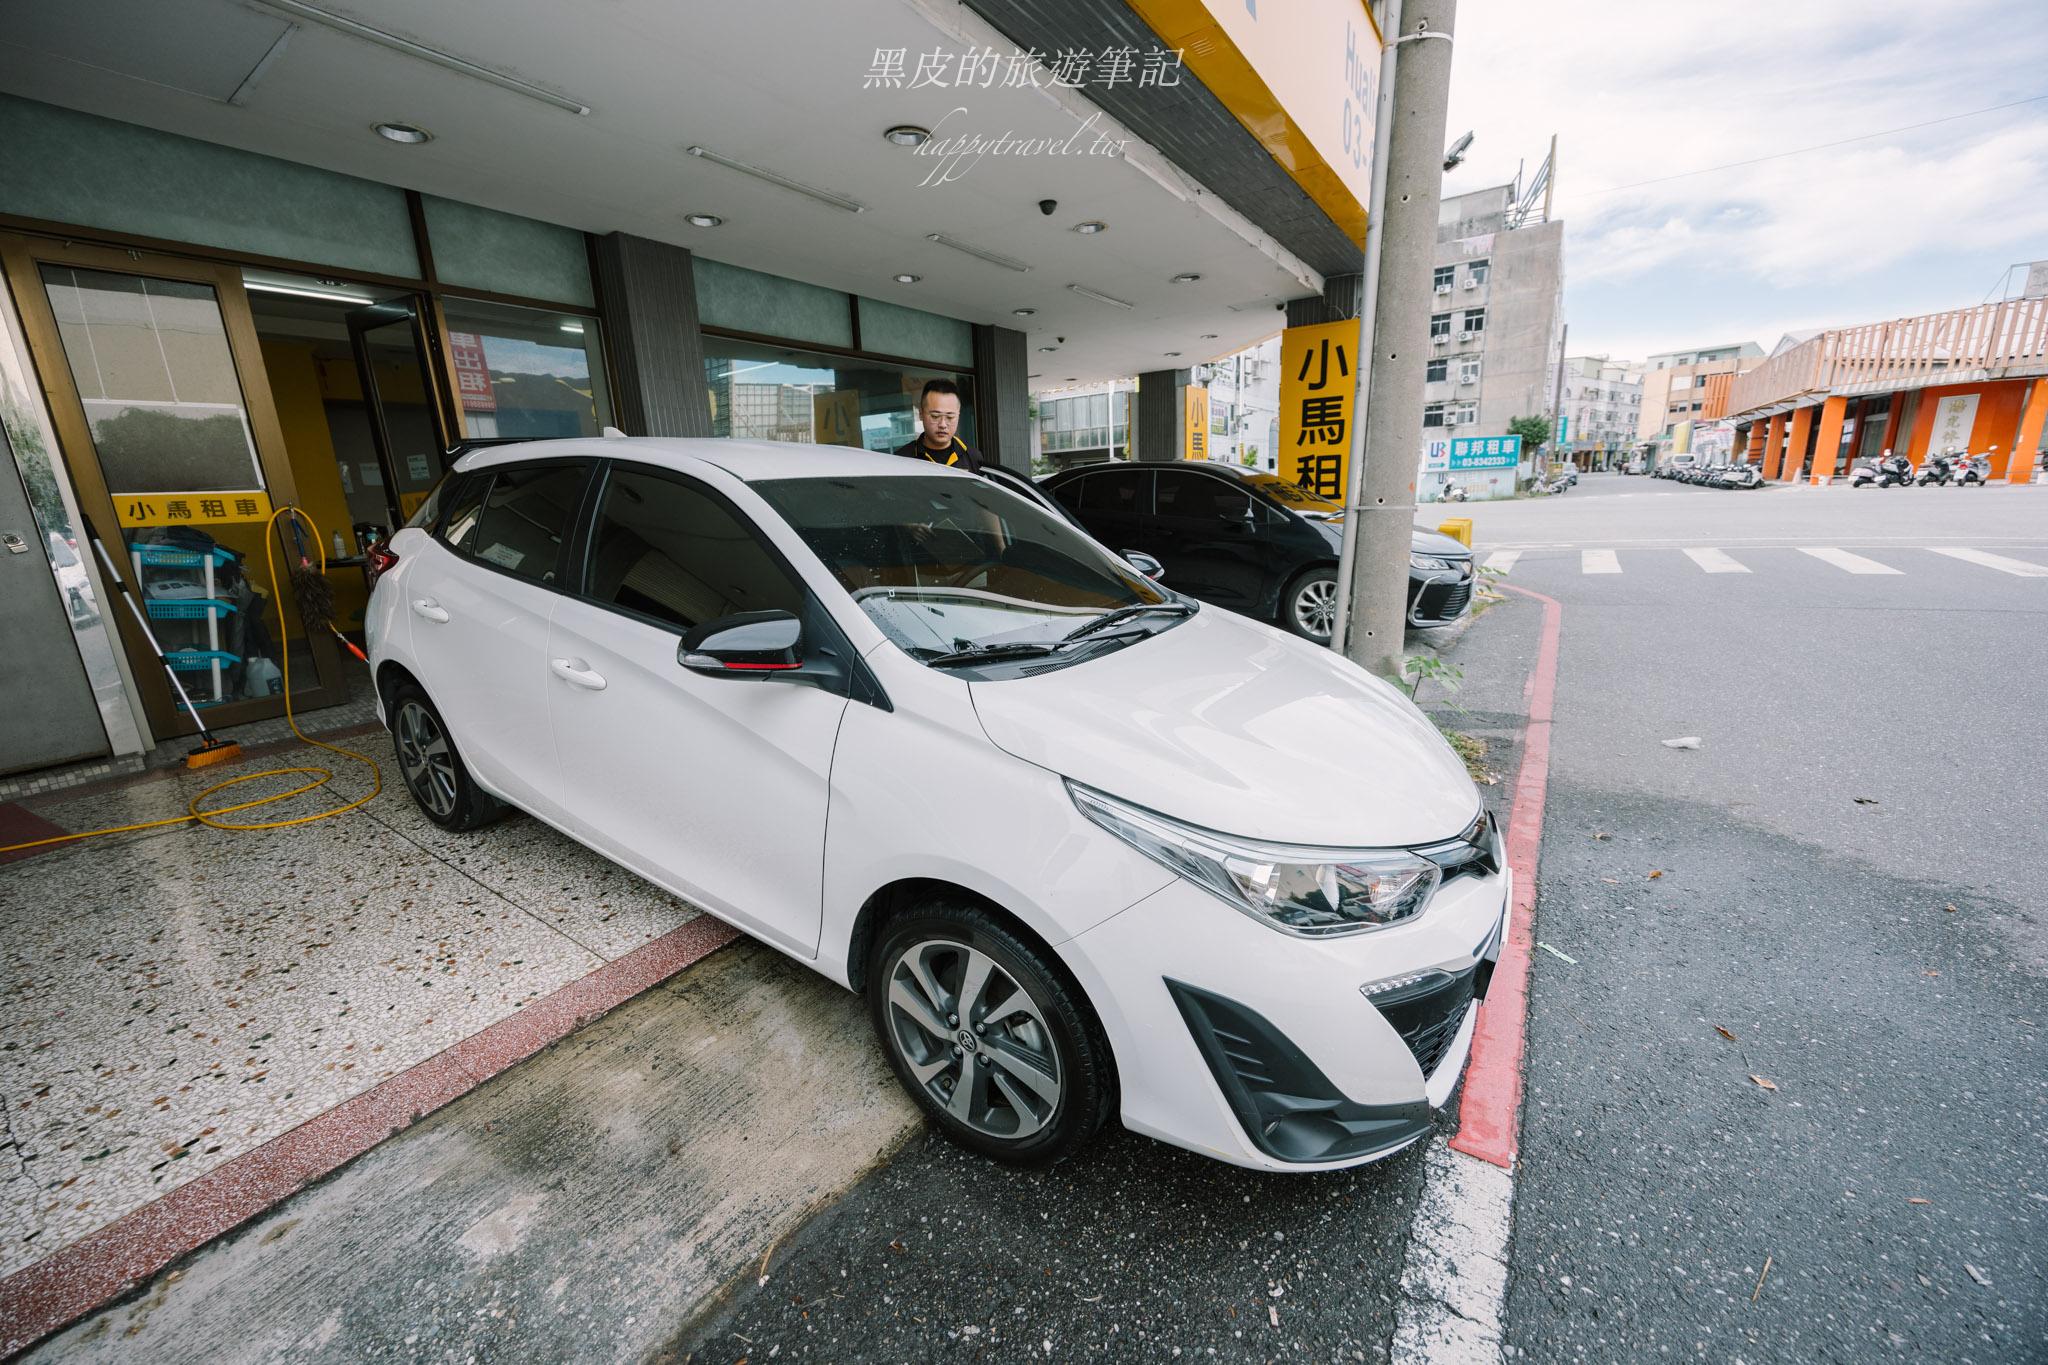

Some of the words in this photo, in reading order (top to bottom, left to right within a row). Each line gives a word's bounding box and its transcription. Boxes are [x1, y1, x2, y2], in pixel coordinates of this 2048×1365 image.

[1344, 21, 1378, 127] Huali
[1296, 338, 1349, 500] 小馬租
[1454, 439, 1515, 456] 聯邦租車
[128, 498, 260, 521] 小馬租車
